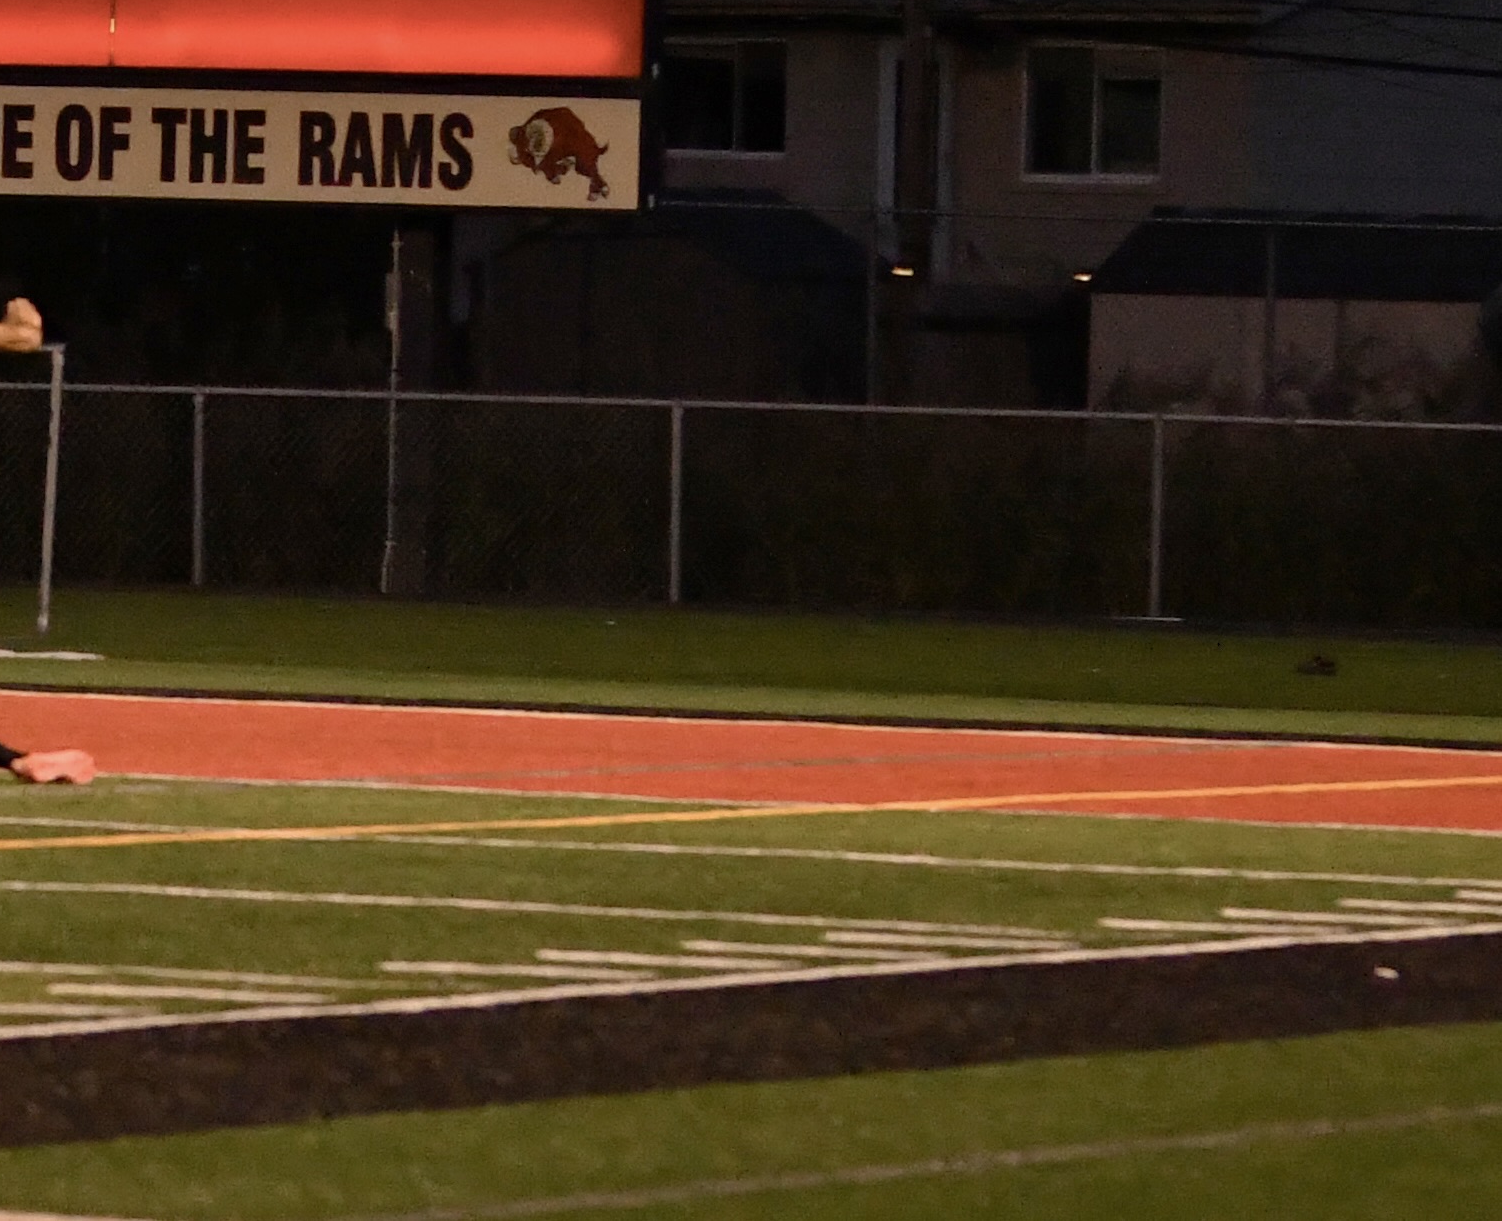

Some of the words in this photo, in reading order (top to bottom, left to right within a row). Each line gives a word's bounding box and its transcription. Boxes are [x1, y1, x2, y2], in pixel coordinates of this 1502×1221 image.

[55, 103, 132, 181] OF
[151, 107, 266, 185] THE
[298, 111, 474, 190] RAMS
